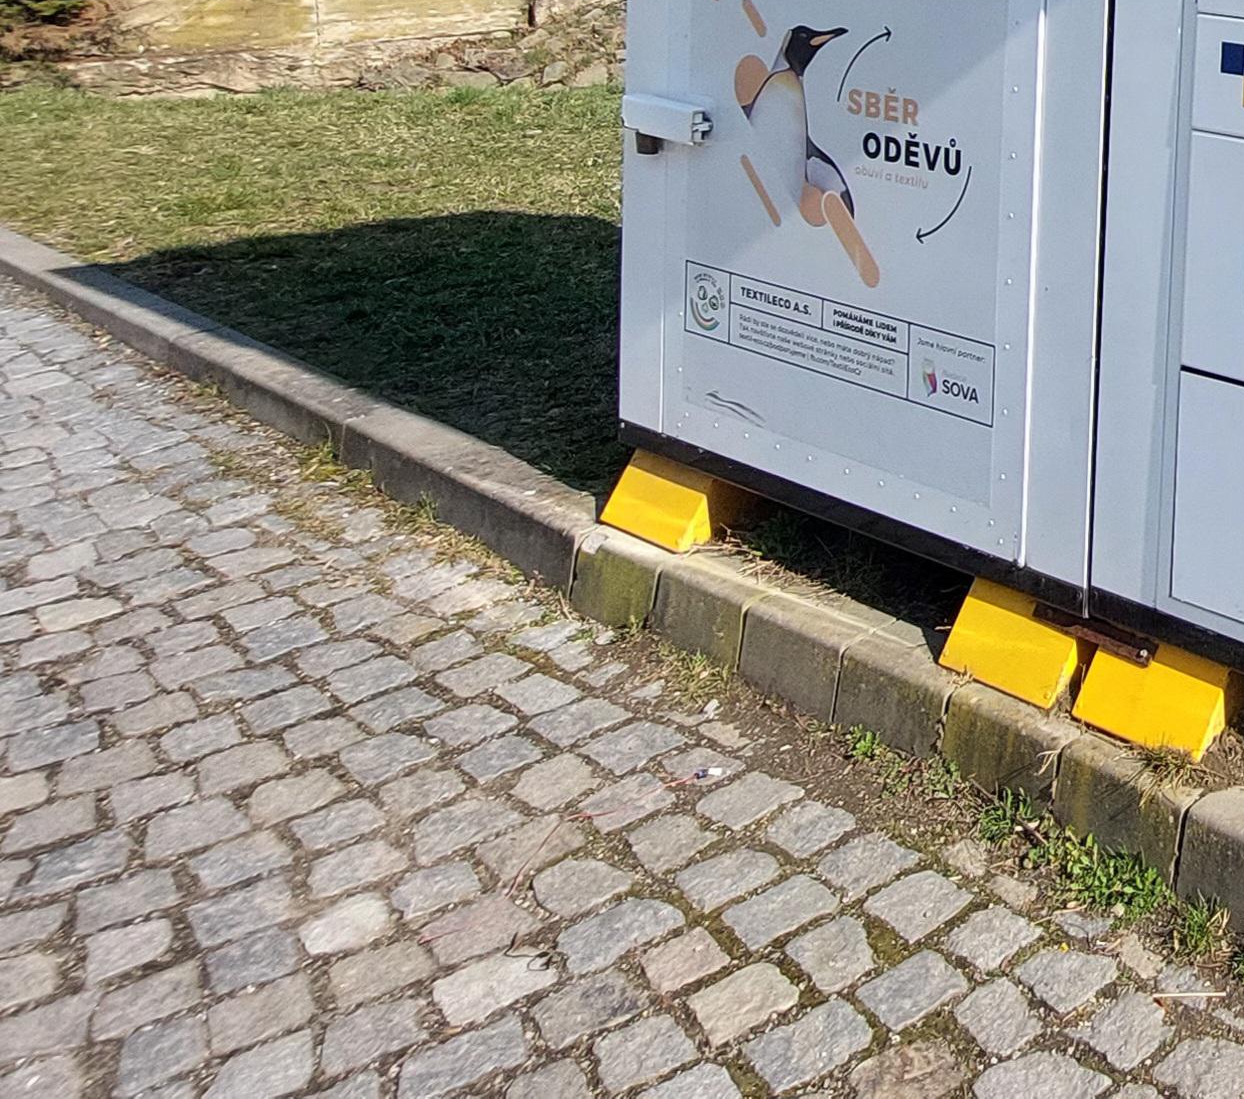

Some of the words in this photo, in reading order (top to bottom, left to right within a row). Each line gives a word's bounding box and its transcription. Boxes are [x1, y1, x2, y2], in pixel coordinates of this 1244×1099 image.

[847, 87, 919, 126] SBĚR
[862, 132, 962, 176] ODĚVŮ
[741, 286, 792, 310] TEXTILECO
[793, 300, 812, 316] A.S.
[881, 332, 897, 344] VÁM
[941, 378, 979, 404] SOVA
